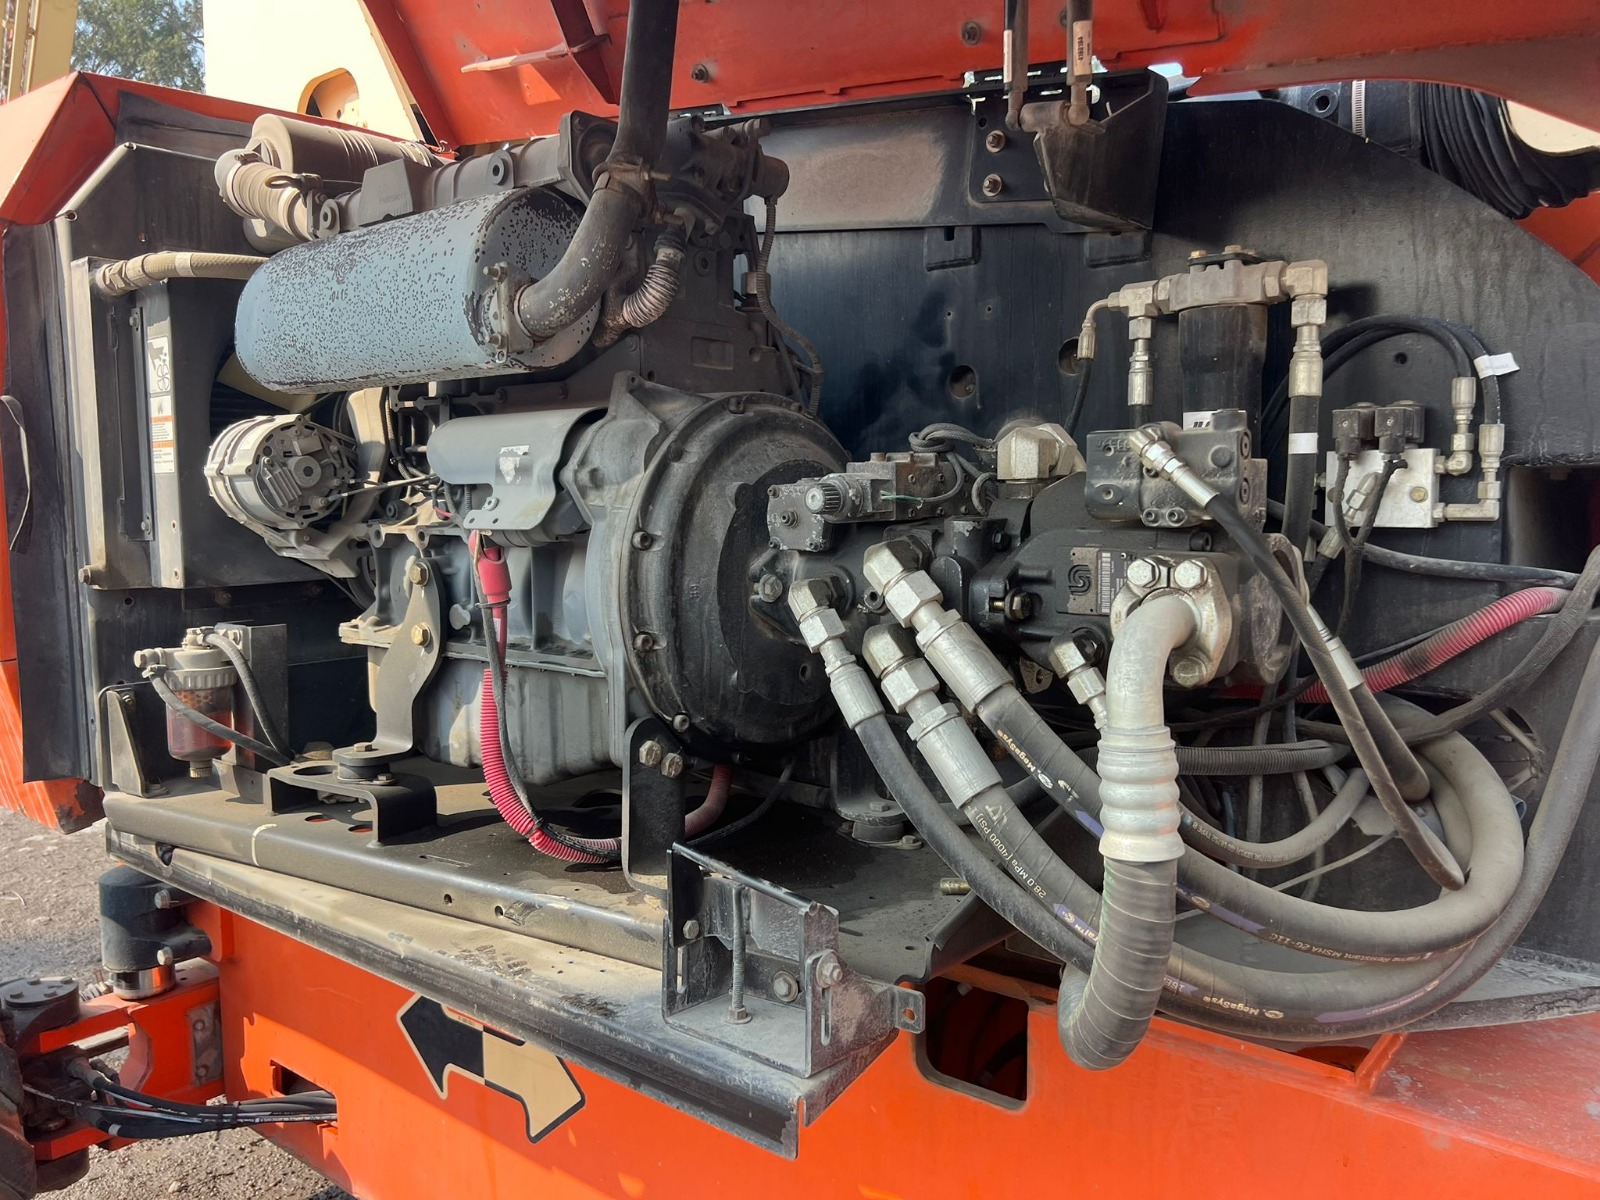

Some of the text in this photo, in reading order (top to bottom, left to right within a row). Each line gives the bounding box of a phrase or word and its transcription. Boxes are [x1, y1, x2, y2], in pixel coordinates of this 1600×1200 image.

[975, 813, 991, 834] PSI)
[989, 833, 1014, 861] (4000
[1011, 859, 1028, 880] MPa
[1026, 878, 1047, 898] 28.0
[1311, 946, 1342, 959] MSHA
